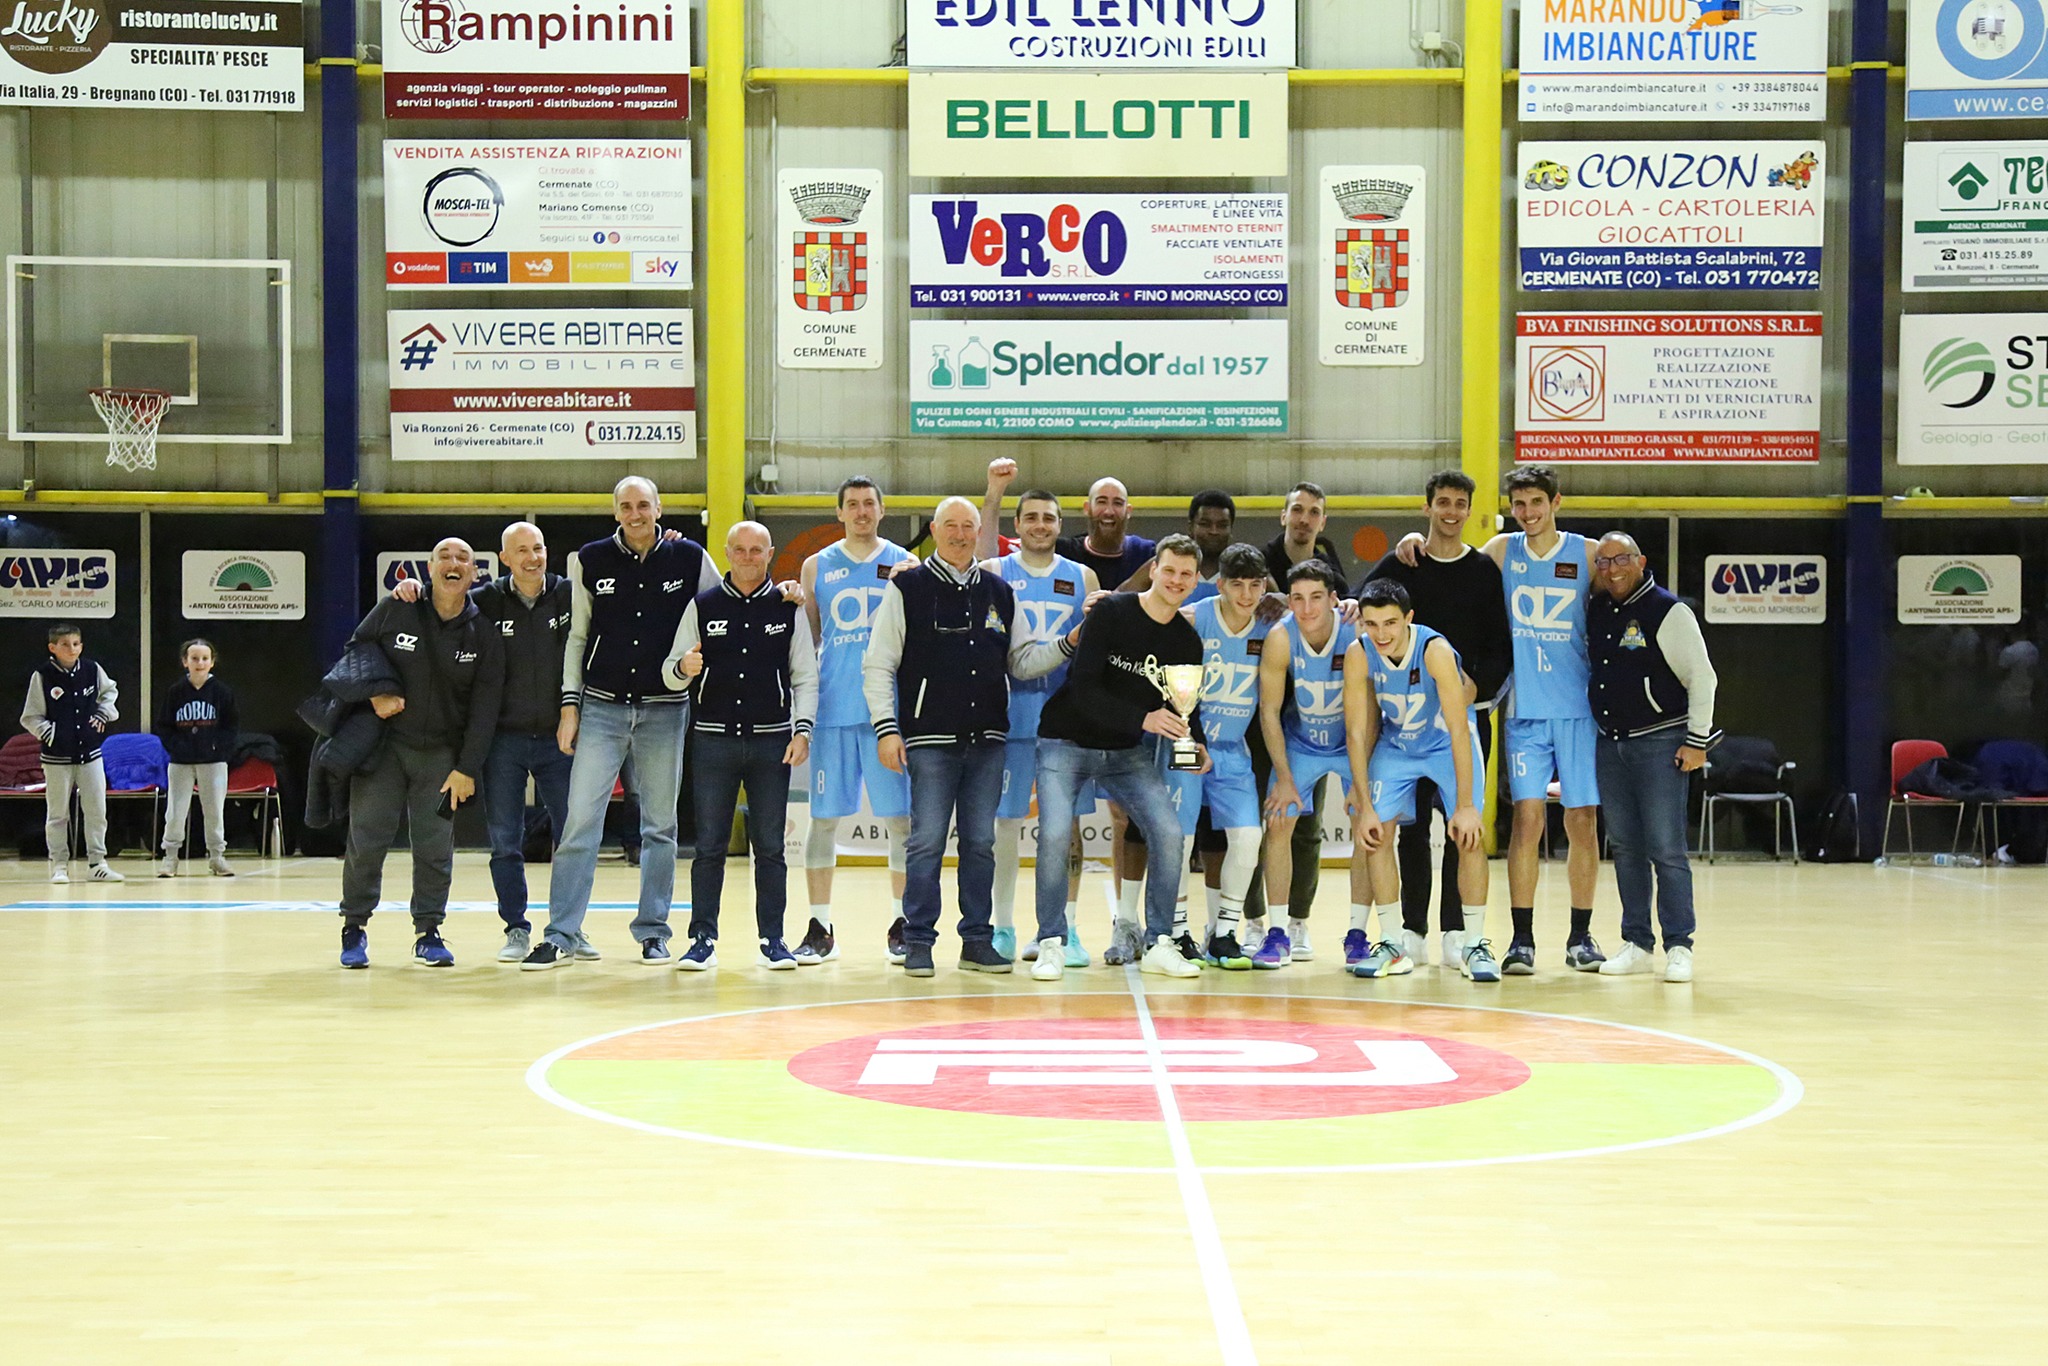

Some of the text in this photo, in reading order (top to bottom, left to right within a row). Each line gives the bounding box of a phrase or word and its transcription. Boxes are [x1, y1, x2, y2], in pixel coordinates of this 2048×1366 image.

[1544, 0, 1686, 23] MARANDO
[1, 0, 100, 44] Lucky
[120, 9, 278, 32] ristorantelucky.it
[412, 0, 673, 49] Rampinini
[9, 44, 92, 53] RISTORANTE PIZZERIA
[1008, 36, 1267, 58] COSTRUZIONI EDILI
[1543, 31, 1757, 61] IMBIANCATURE
[223, 51, 269, 67] PESCE
[406, 83, 667, 95] agenzia viaggi tour operator noleggio pullman
[1542, 82, 1819, 93] www.marandoimbiancature.it 3384878044
[19, 84, 296, 104] Italia, 29 Bregnano (CO) Tel. 031 771918
[396, 97, 678, 110] servizi logistici trasporti distribuzione magazzini
[1542, 102, 1811, 113] info@marandoimbiancature.it 3347197168
[946, 100, 1250, 139] BELLOTTI
[393, 147, 682, 160] VENDITA ASSISTENZA RIPARAZIONI
[1577, 153, 1758, 190] CONZON
[538, 180, 619, 190] Cermenate (CO)
[434, 199, 491, 210] MOSCA-TEL
[538, 203, 654, 213] Mariano Comense (CO)
[1140, 199, 1283, 209] COPERTURE, LATTONERIE
[1527, 199, 1815, 217] EDICOLA CARTOLERIA
[1212, 209, 1283, 218] E LINEE VITA
[1151, 223, 1284, 233] SMALTIMENTO ETERNIT
[539, 233, 575, 244] Seguici
[1598, 226, 1743, 243] GIOCATTOLI
[1166, 239, 1283, 249] FACCIATE VENTILATE
[1213, 255, 1284, 264] ISOLAMENTI
[1539, 251, 1805, 267] Via Giovan Battista Scalabrini, 72
[1959, 250, 2033, 260] 031.415.25.89
[407, 263, 440, 271] vodafone
[473, 262, 497, 274] TIM
[645, 257, 679, 277] sky
[1051, 264, 1097, 278] S.R.L.
[1203, 270, 1284, 280] CARTONGESSI
[1522, 270, 1819, 288] CERMENATE (CO) Tel. 031 770472
[915, 288, 1284, 303] Tel. 031 900131 www.verco.it FINO MORNASCO (CO)
[803, 324, 856, 334] COMUNE
[1344, 321, 1398, 331] COMUNE
[1525, 319, 1814, 334] BVA FINISHING SOLUTIONS S.R.L.
[452, 321, 683, 346] VIVERE ABITARE
[1365, 333, 1377, 342] DI
[824, 336, 836, 346] DI
[793, 347, 867, 358] CERMENATE
[1334, 344, 1408, 354] CERMENATE
[1653, 347, 1775, 358] PROGETTAZIONE
[452, 358, 684, 370] IMMOBILIARE
[992, 340, 1269, 386] Splendor dal 1957
[1656, 363, 1771, 373] REALIZZAZIONE
[1649, 378, 1778, 389] E MANUTENZIONE
[453, 391, 632, 408] www.vivereabitare.it
[1613, 393, 1813, 404] IMPIANTI DI VERNICIATURA
[916, 406, 1279, 416] PULIZIE DI OGNI GENERE INDUSTRIALI CIVILI SANIFICAZIONE DISINFEZIONE
[1658, 409, 1767, 420] E ASPIRAZIONE
[402, 422, 575, 434] Via Ronzoni 26 Cermenate (CO)
[916, 417, 1207, 429] Via Cumano 41, 22100 COMO www.puliziesplendor.it
[598, 425, 682, 442] 031.72.24.15
[1520, 434, 1686, 445] BREGNANO VIA LIBERO GRASSI,
[1921, 430, 1993, 446] Geologia
[434, 436, 544, 447] info@vivereabitare.it
[1520, 447, 1813, 458] INFO@BVAIMPIANTI.COM WWW.BVAIMPIANTI.COM
[0, 556, 110, 589] AVIS
[1711, 562, 1820, 595] AVIS
[1536, 645, 1552, 672] 15
[176, 700, 217, 721] ROBUR
[1203, 719, 1221, 742] 14
[1308, 728, 1329, 747] 20
[1511, 751, 1527, 778] 15
[817, 769, 825, 795] 8
